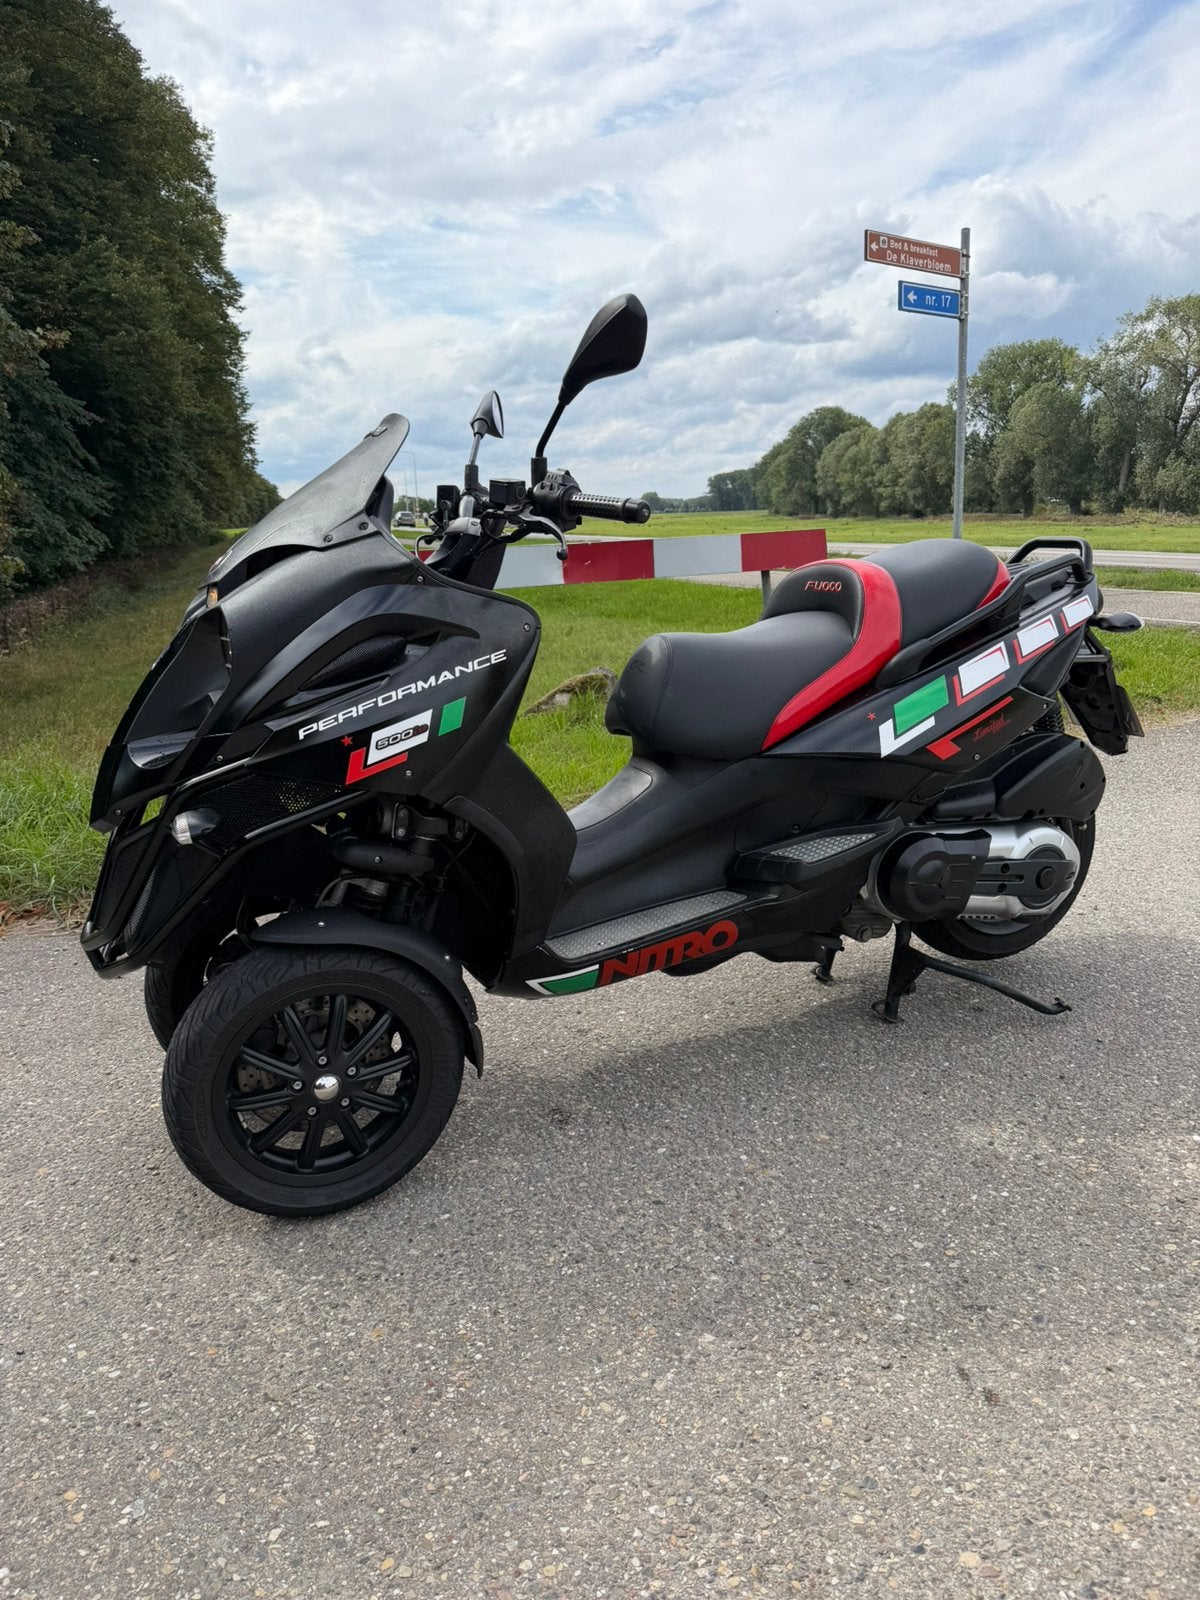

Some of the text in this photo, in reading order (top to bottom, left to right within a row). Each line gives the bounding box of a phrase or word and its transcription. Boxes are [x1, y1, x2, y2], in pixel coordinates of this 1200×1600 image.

[890, 240, 938, 257] Bed & breakfast
[886, 250, 952, 272] De Klaverbloem
[925, 295, 952, 308] nr. 17
[804, 581, 842, 592] FUOCO
[298, 649, 507, 740] PERFORMANCE
[601, 919, 739, 986] NITRO
